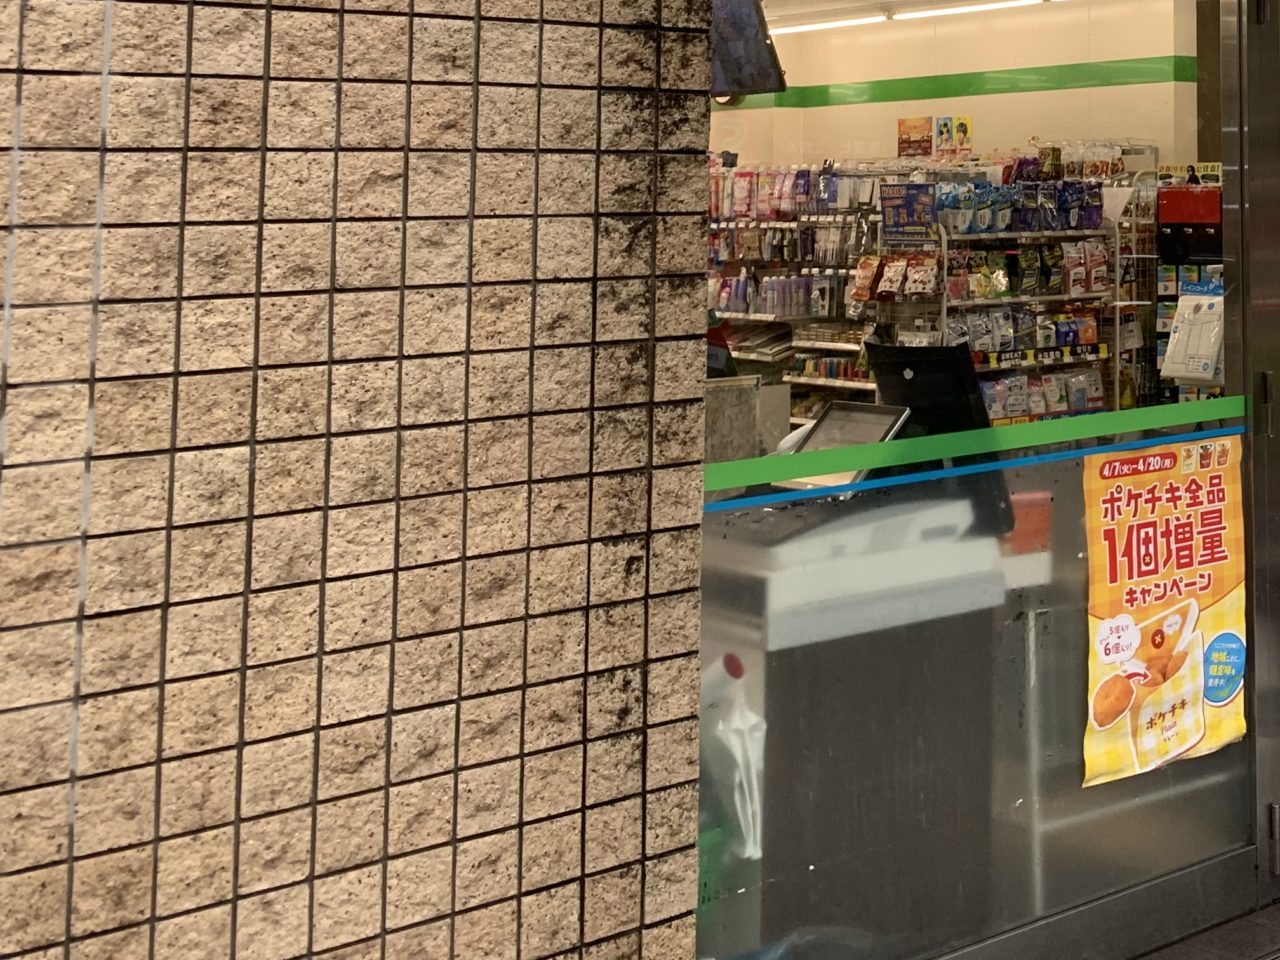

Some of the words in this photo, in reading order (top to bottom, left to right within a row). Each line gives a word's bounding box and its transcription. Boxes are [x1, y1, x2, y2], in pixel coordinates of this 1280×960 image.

[1102, 474, 1226, 522] ポケチキ全品
[1103, 508, 1229, 585] 1個増量
[1125, 573, 1212, 607] キャンペーン
[1146, 699, 1188, 730] ポケチキ
